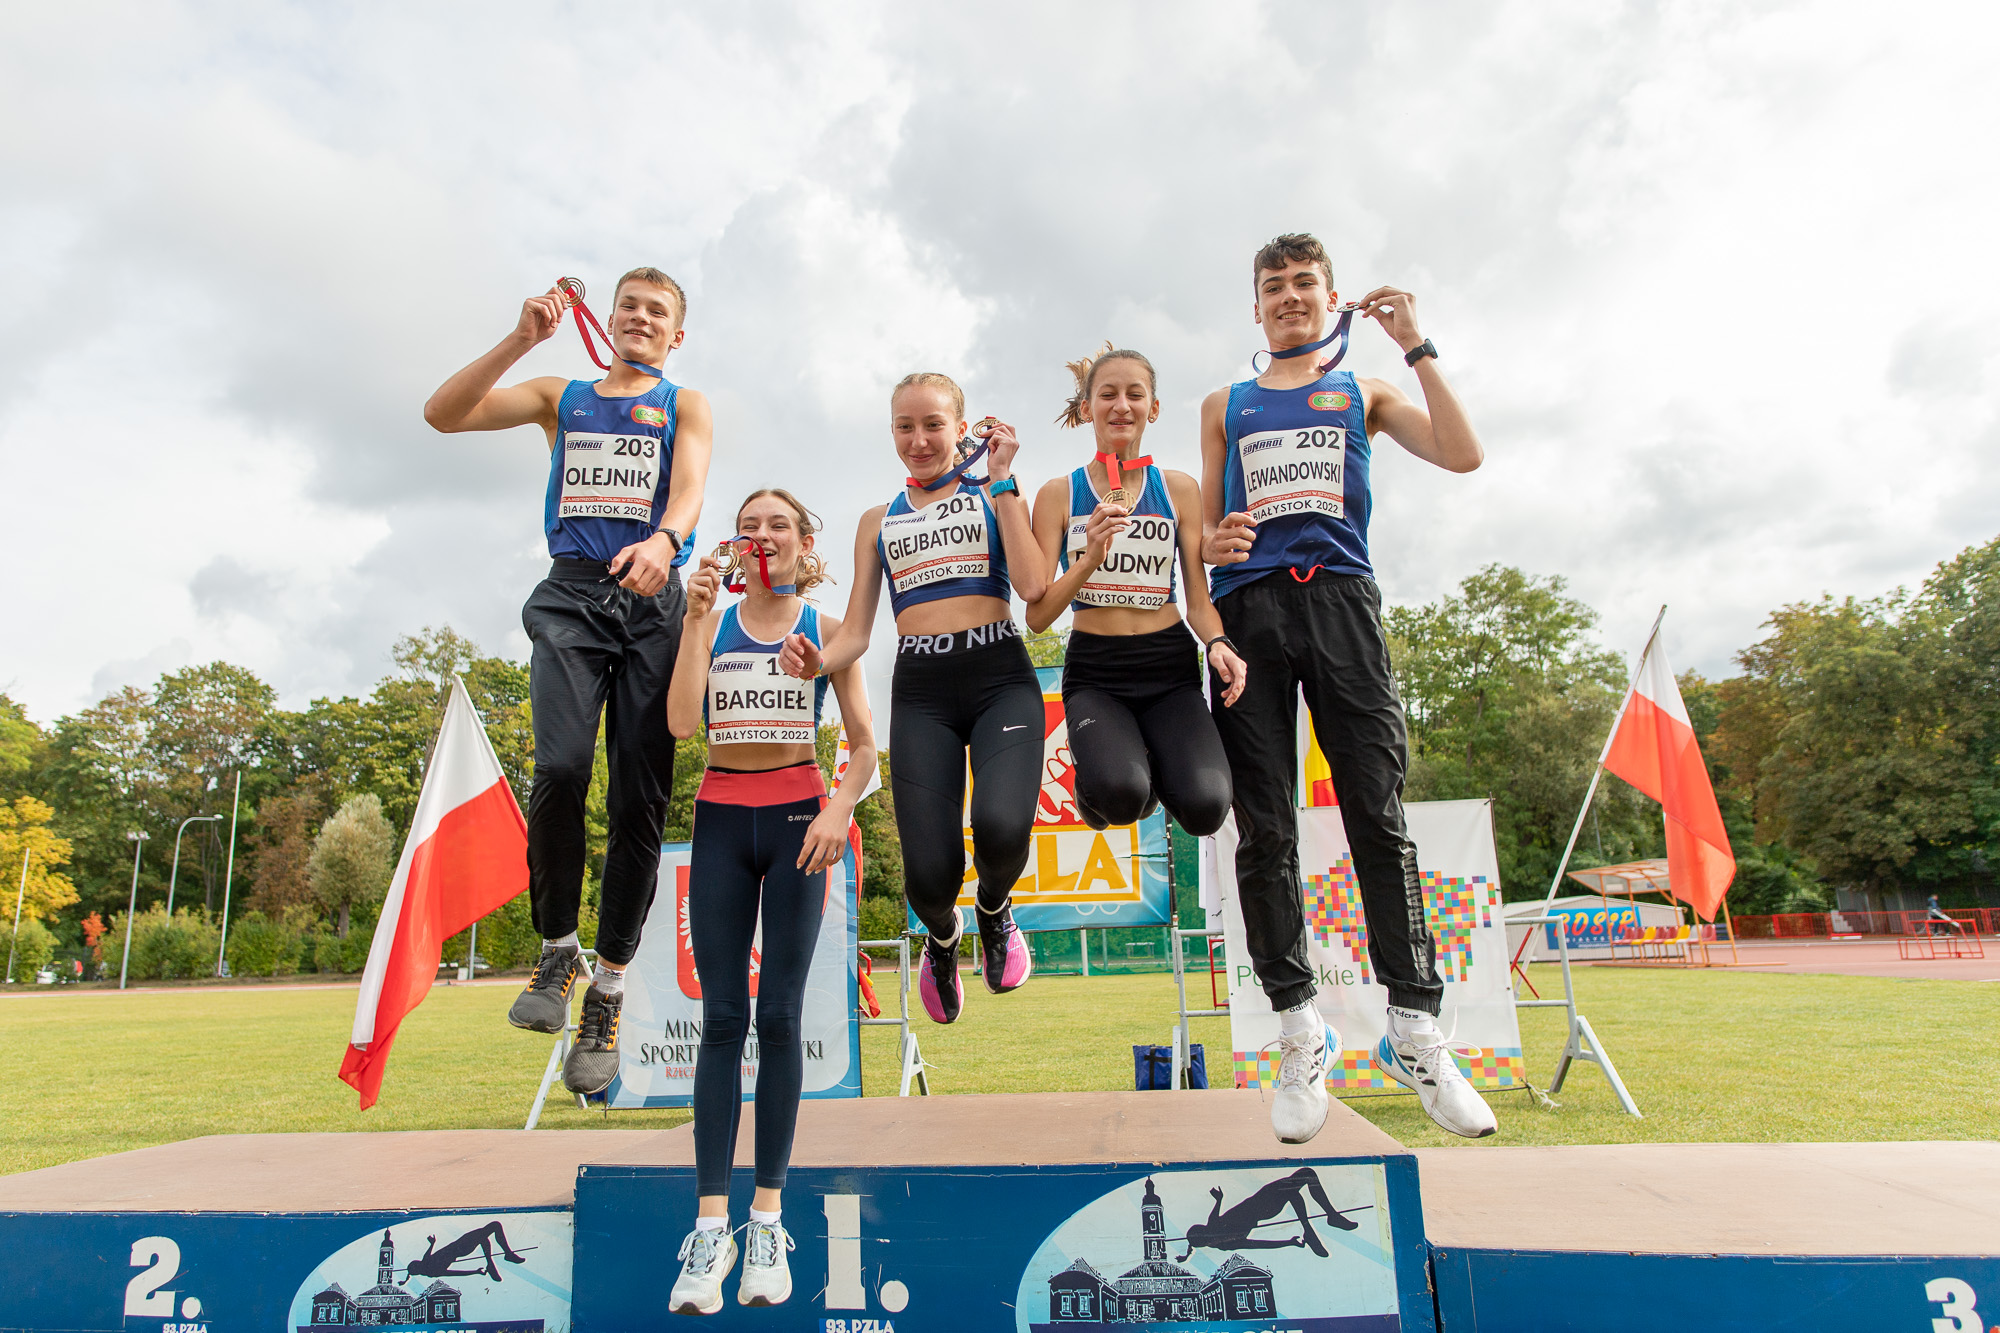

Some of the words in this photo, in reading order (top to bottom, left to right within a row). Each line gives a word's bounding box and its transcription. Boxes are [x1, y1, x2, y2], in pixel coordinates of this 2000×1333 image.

[613, 438, 655, 458] 203
[1295, 430, 1340, 450] 202
[565, 468, 652, 490] OLEJNIK
[1246, 461, 1341, 493] LEWANDOWSKI
[563, 504, 620, 515] BIAŁYSTOK
[623, 506, 648, 518] 2022
[935, 496, 978, 521] 201
[1252, 500, 1312, 520] BIAŁYSTOK
[1316, 500, 1339, 514] 2022
[1127, 519, 1170, 541] 200
[888, 524, 982, 561] GIEJBATOW
[899, 566, 953, 590] BIAŁYSTOK
[957, 564, 984, 574] 2022
[1076, 591, 1135, 604] BIAŁYSTOK
[1139, 595, 1163, 606] 2022
[900, 634, 954, 654] PRO
[966, 619, 1022, 649] NIKE
[715, 690, 807, 711] BARGIEŁ
[715, 730, 777, 742] BIAŁYSTOK
[781, 730, 809, 740] 2022
[823, 1193, 910, 1313] 1.
[124, 1235, 202, 1320] 2.
